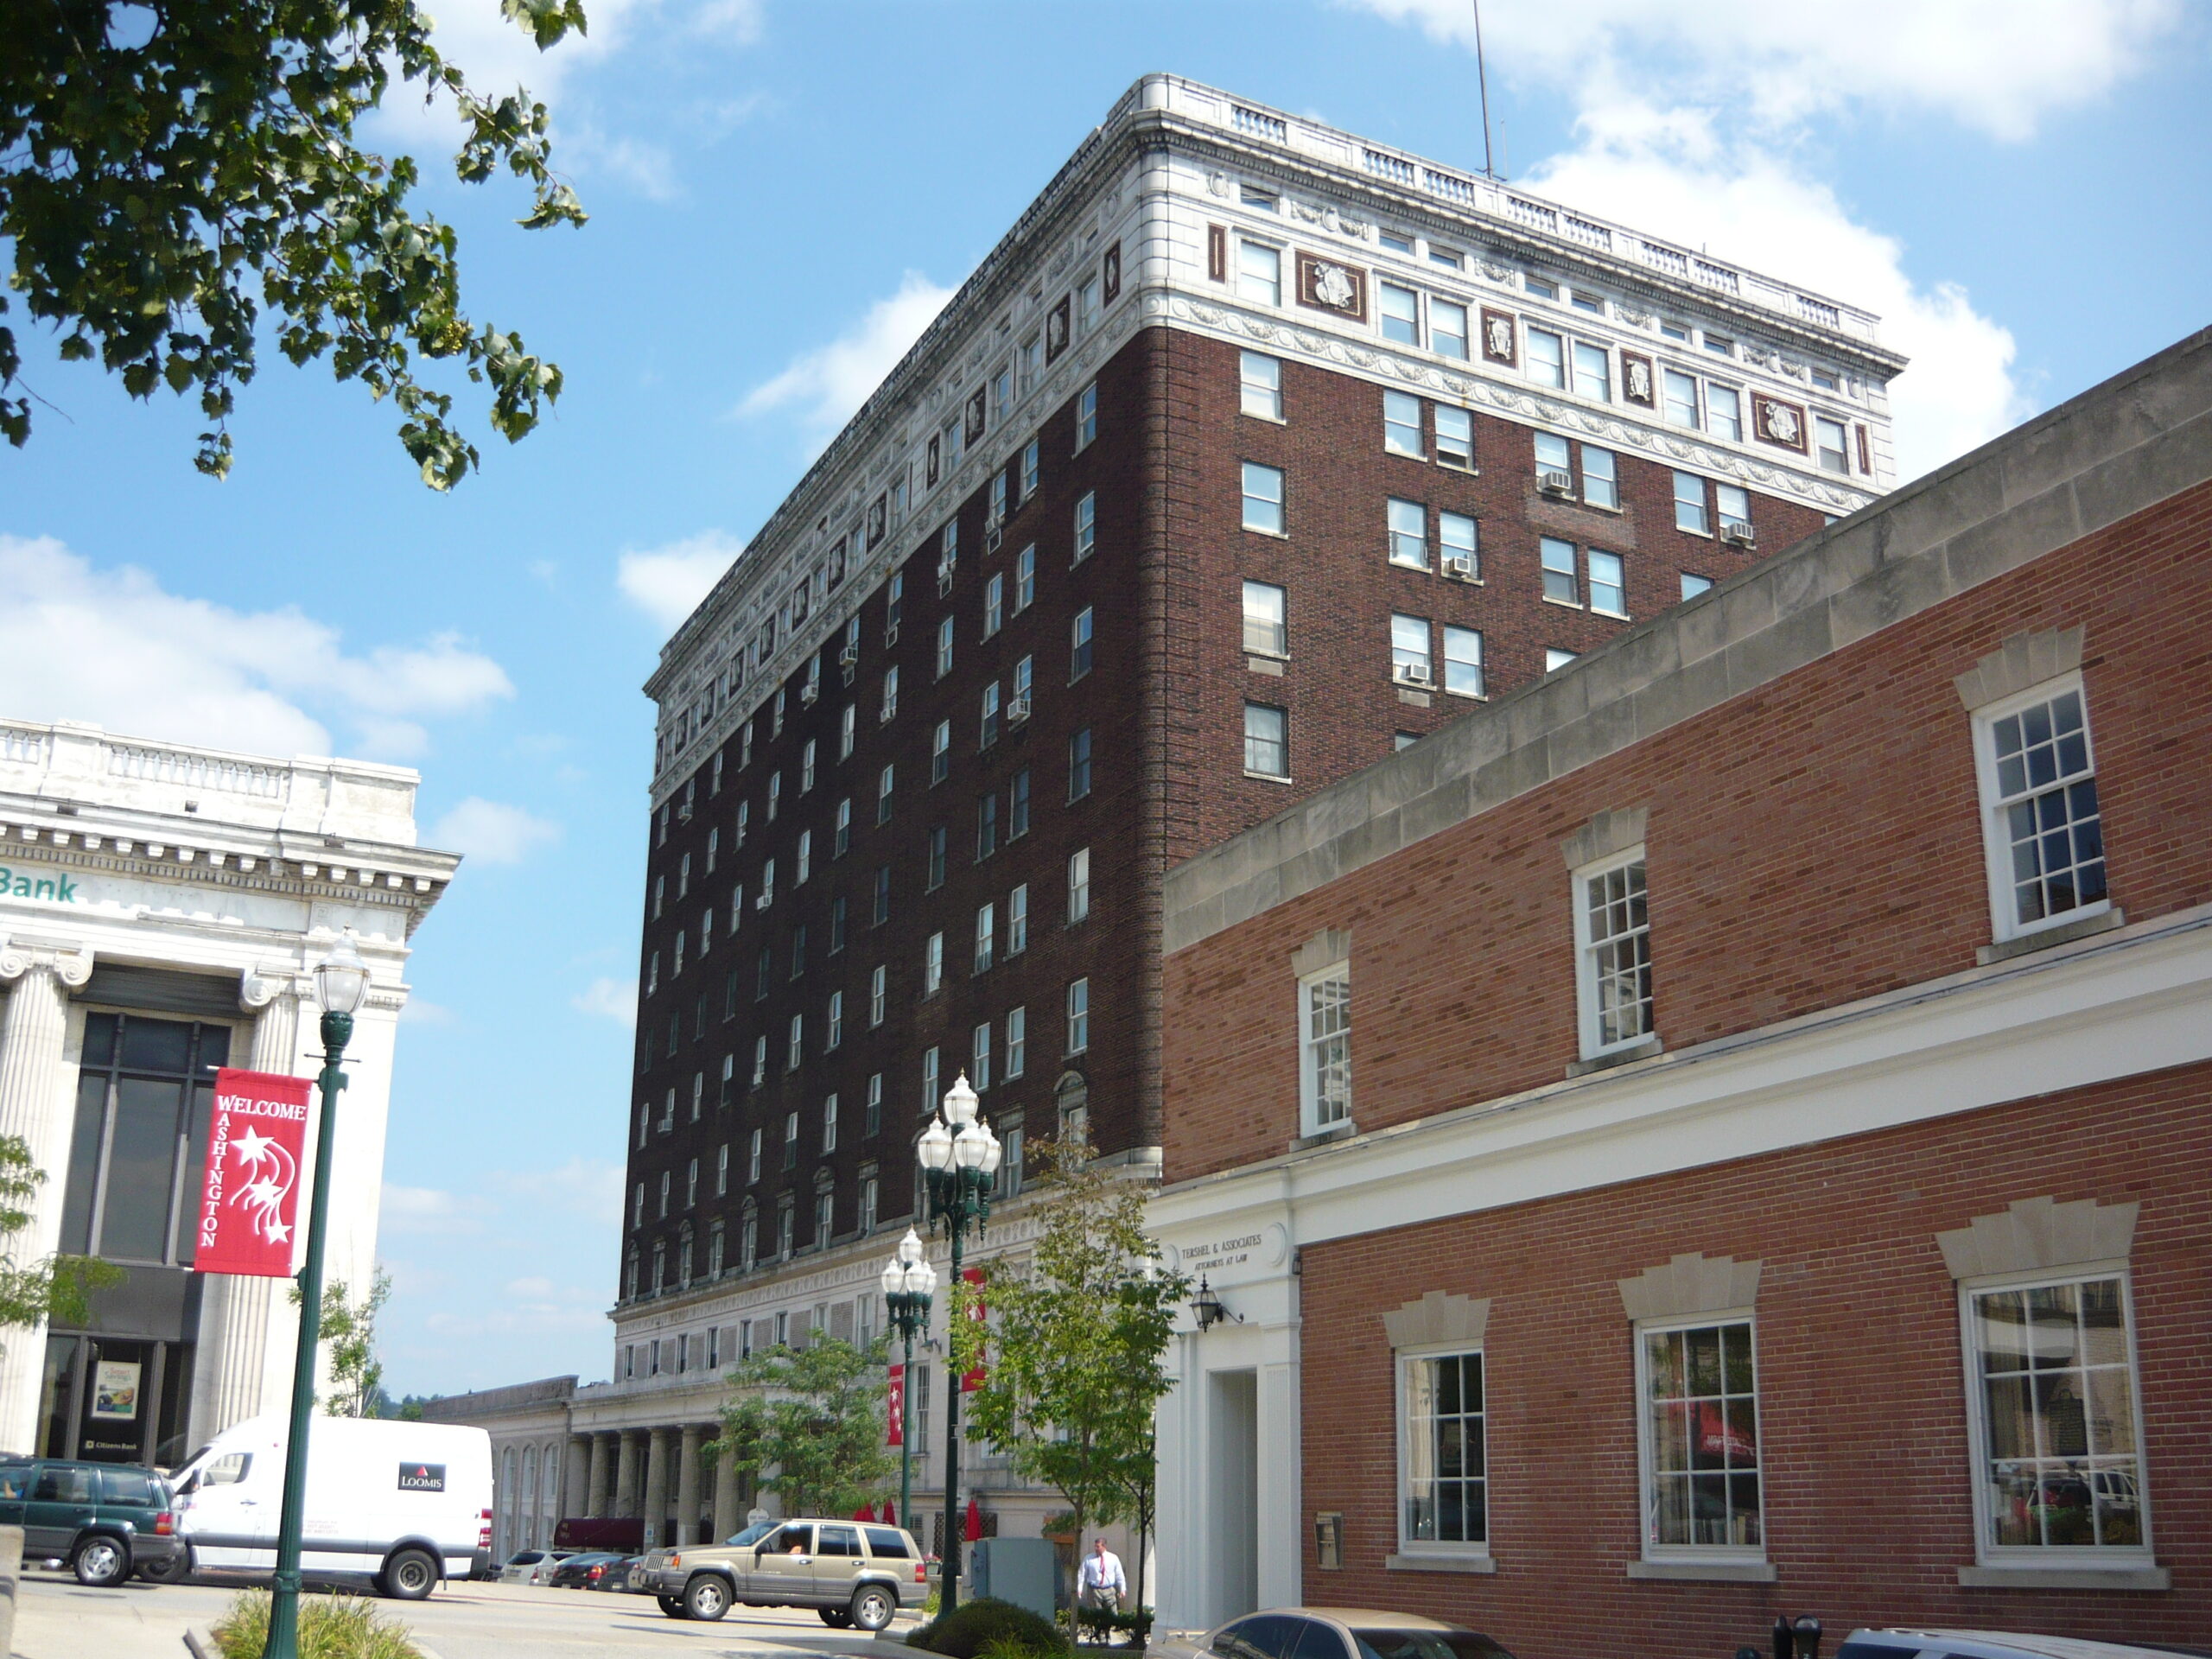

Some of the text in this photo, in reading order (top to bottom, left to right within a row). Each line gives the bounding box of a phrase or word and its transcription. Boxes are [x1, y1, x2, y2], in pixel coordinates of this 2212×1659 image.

[0, 867, 79, 904] Bank
[217, 1094, 307, 1121] WELCOME
[1182, 1234, 1262, 1259] TERSHEL & ASSOCIATES
[1195, 1254, 1248, 1271] ATTORNEYS AT LAW
[96, 1441, 137, 1451] Citizens Bank
[402, 1476, 442, 1488] LOOMIS
